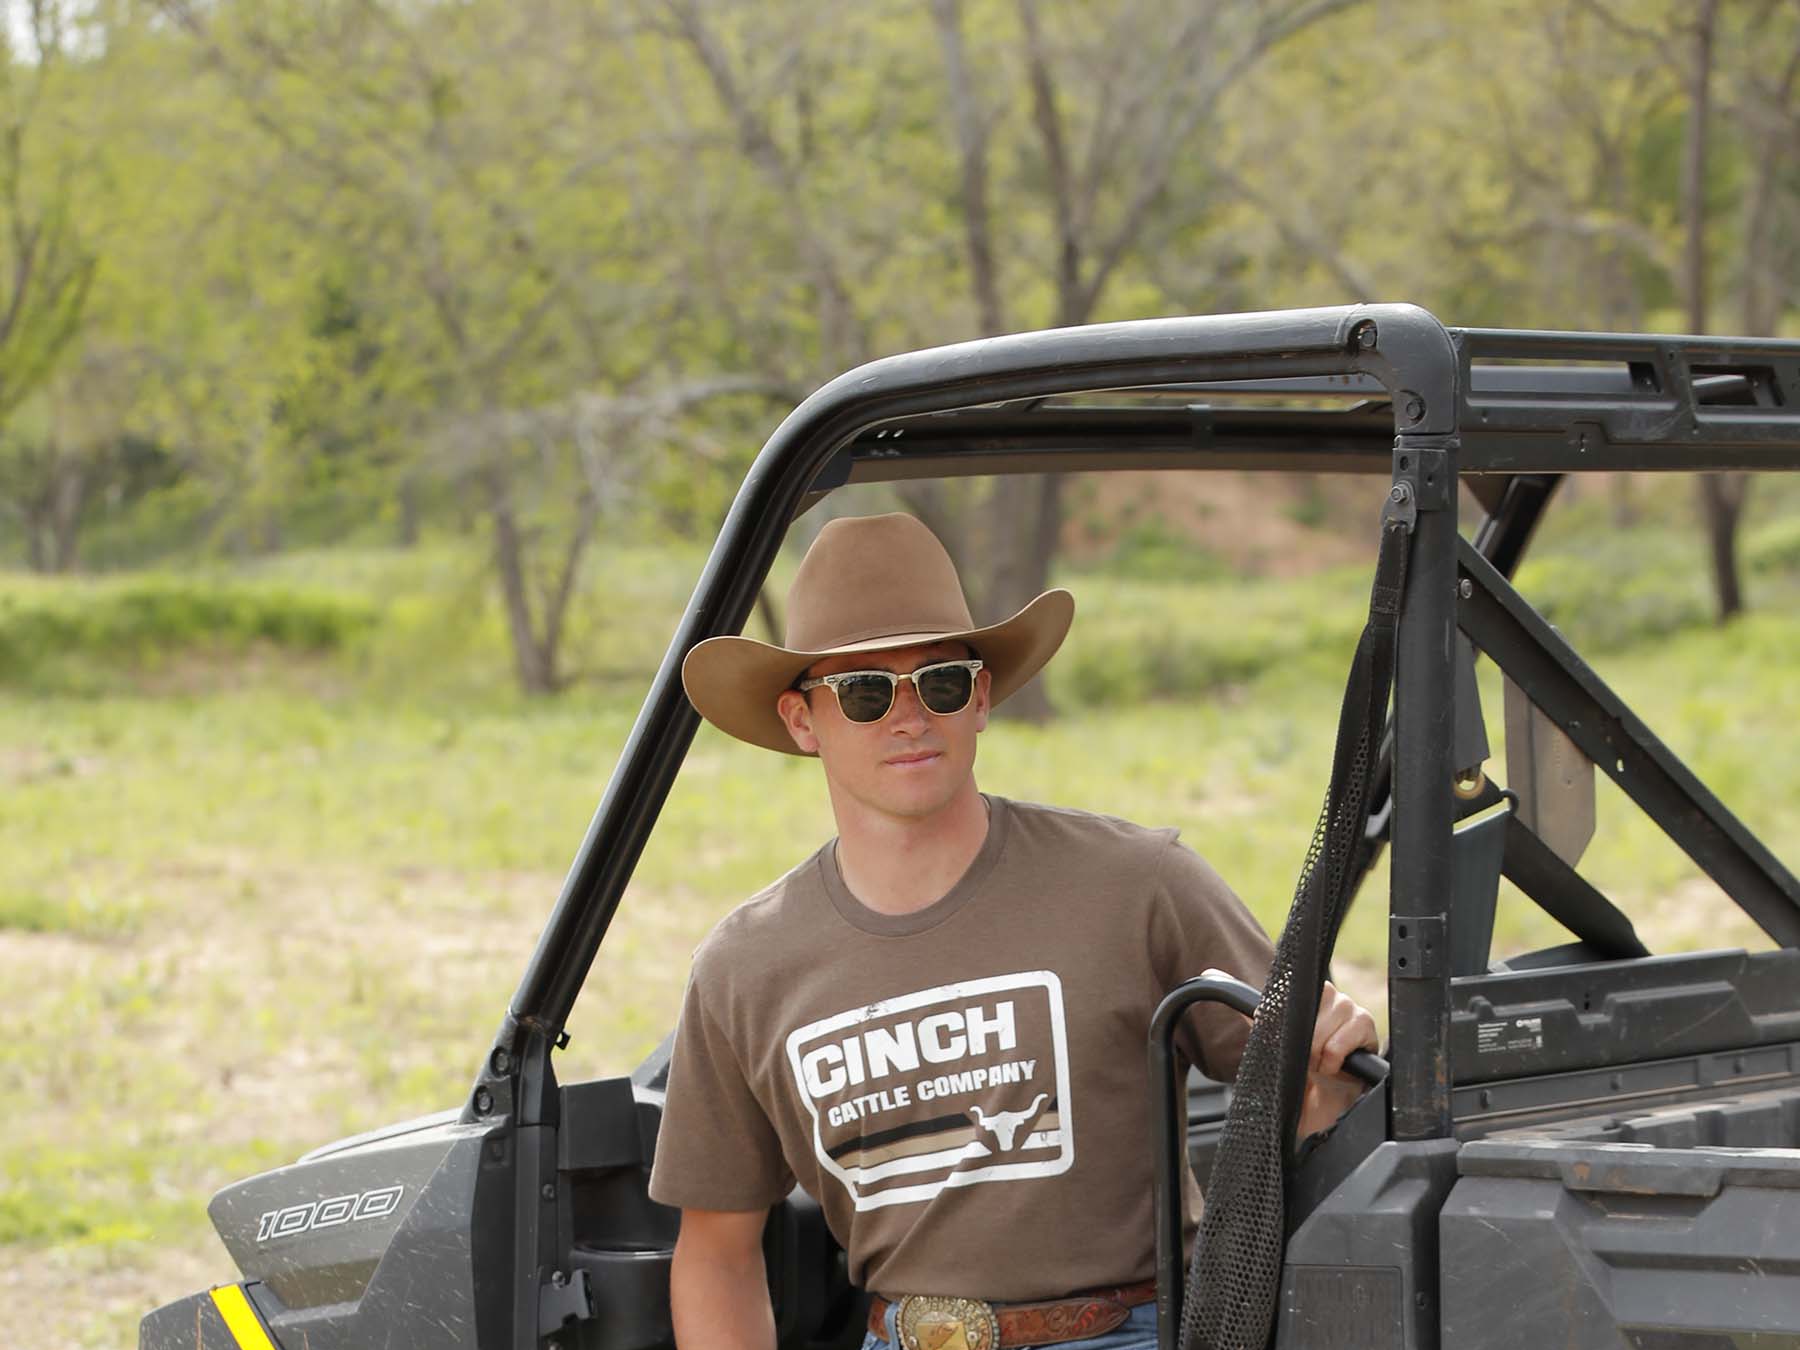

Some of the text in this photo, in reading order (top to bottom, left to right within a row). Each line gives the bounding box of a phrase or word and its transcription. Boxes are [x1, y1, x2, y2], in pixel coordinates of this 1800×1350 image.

[801, 1000, 1017, 1099] CINCH
[827, 1059, 1038, 1127] CATTLE COMPANY
[256, 1185, 404, 1242] 1000
